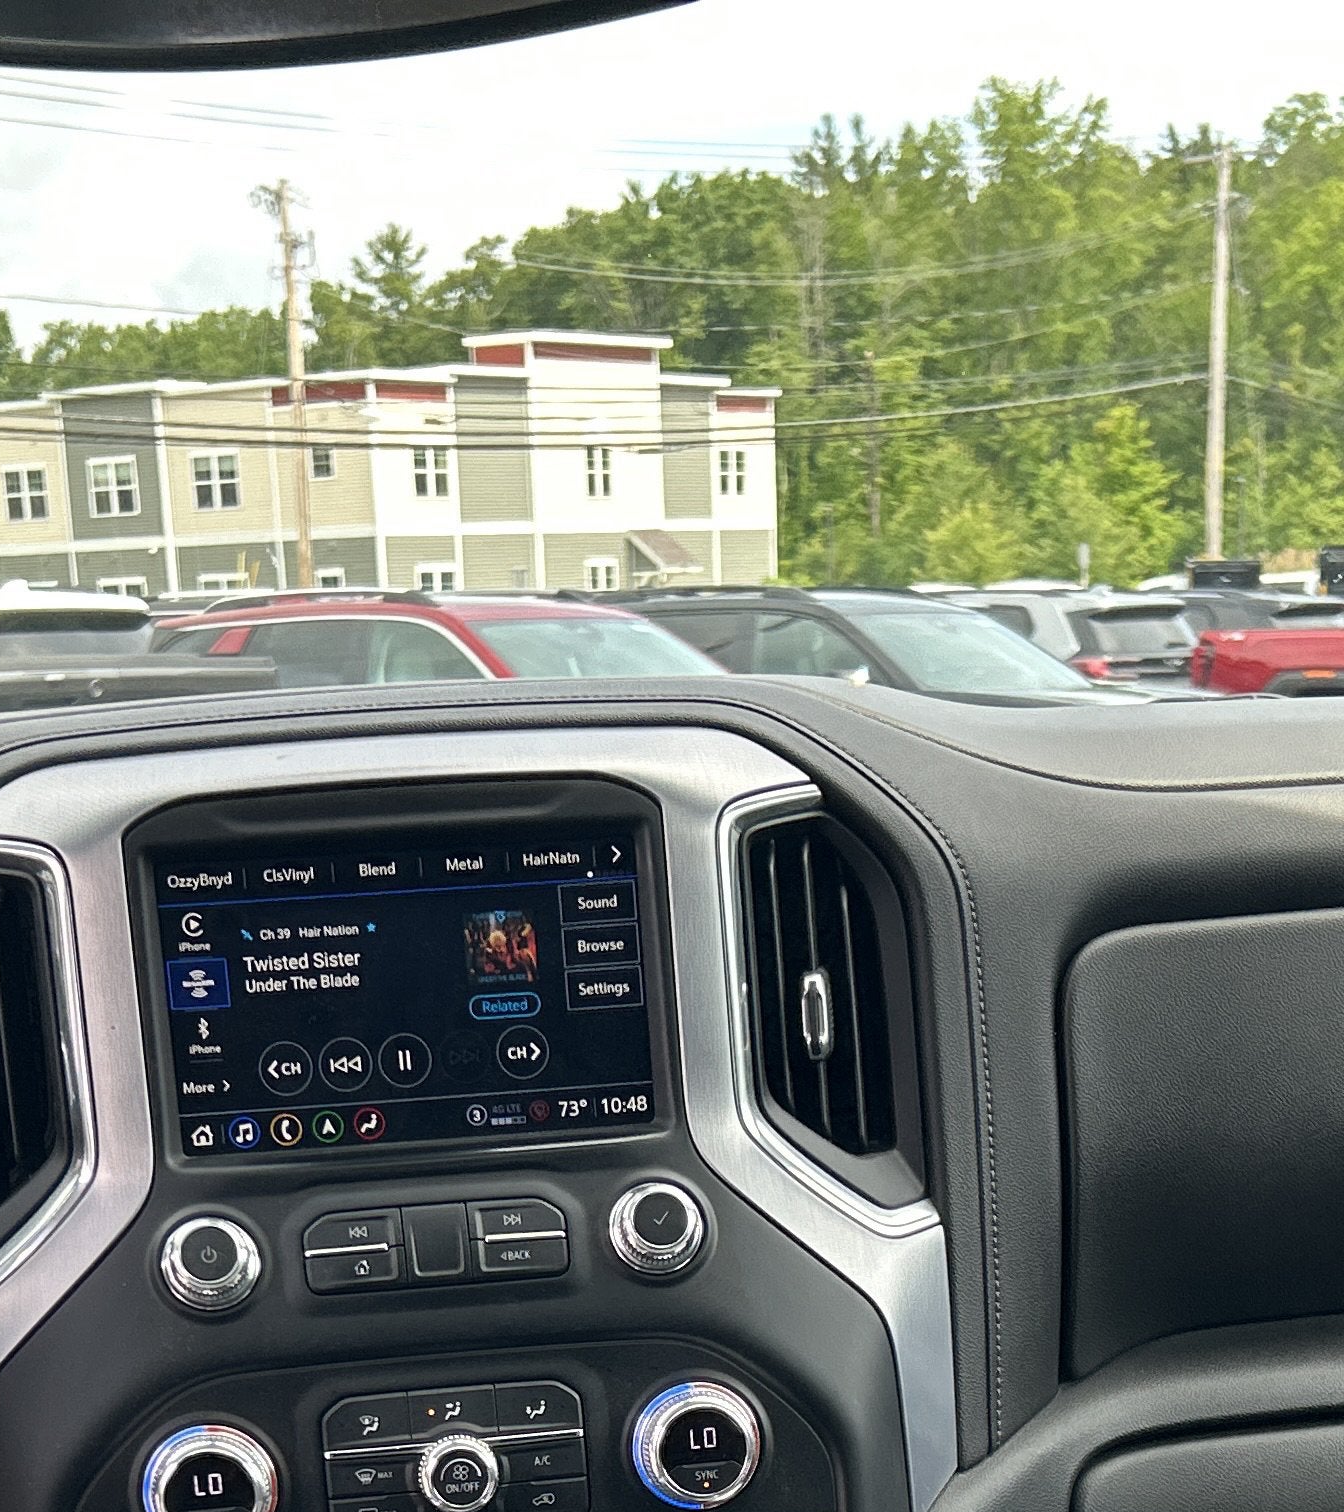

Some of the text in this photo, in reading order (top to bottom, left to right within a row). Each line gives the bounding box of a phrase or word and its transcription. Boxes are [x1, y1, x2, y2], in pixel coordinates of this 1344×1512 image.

[445, 856, 484, 872] Metal
[522, 851, 580, 867] HairNatn
[263, 866, 315, 884] ClsVinyl
[358, 861, 396, 877] Blend
[167, 871, 233, 891] OzzyBnyd
[577, 894, 618, 911] Sound
[259, 924, 360, 941] Ch 39 Hair Nation
[178, 941, 211, 953] iPhone
[577, 938, 625, 954] Browse
[242, 951, 361, 973] Twisted Sister
[245, 973, 360, 994] Under The Blade
[578, 981, 631, 998] Settings
[482, 999, 529, 1013] Related
[189, 1044, 222, 1055] iPhone
[507, 1046, 528, 1060] CH
[280, 1061, 302, 1076] CH
[182, 1082, 215, 1095] More
[558, 1098, 588, 1118] 73°
[600, 1095, 648, 1115] 10:48
[507, 1249, 532, 1261] BACK
[689, 1426, 718, 1451] LO
[534, 1454, 552, 1467] A/C
[377, 1471, 394, 1480] MAX
[694, 1468, 719, 1481] SYNC
[193, 1472, 224, 1497] LO
[445, 1481, 481, 1494] ON/OFF
